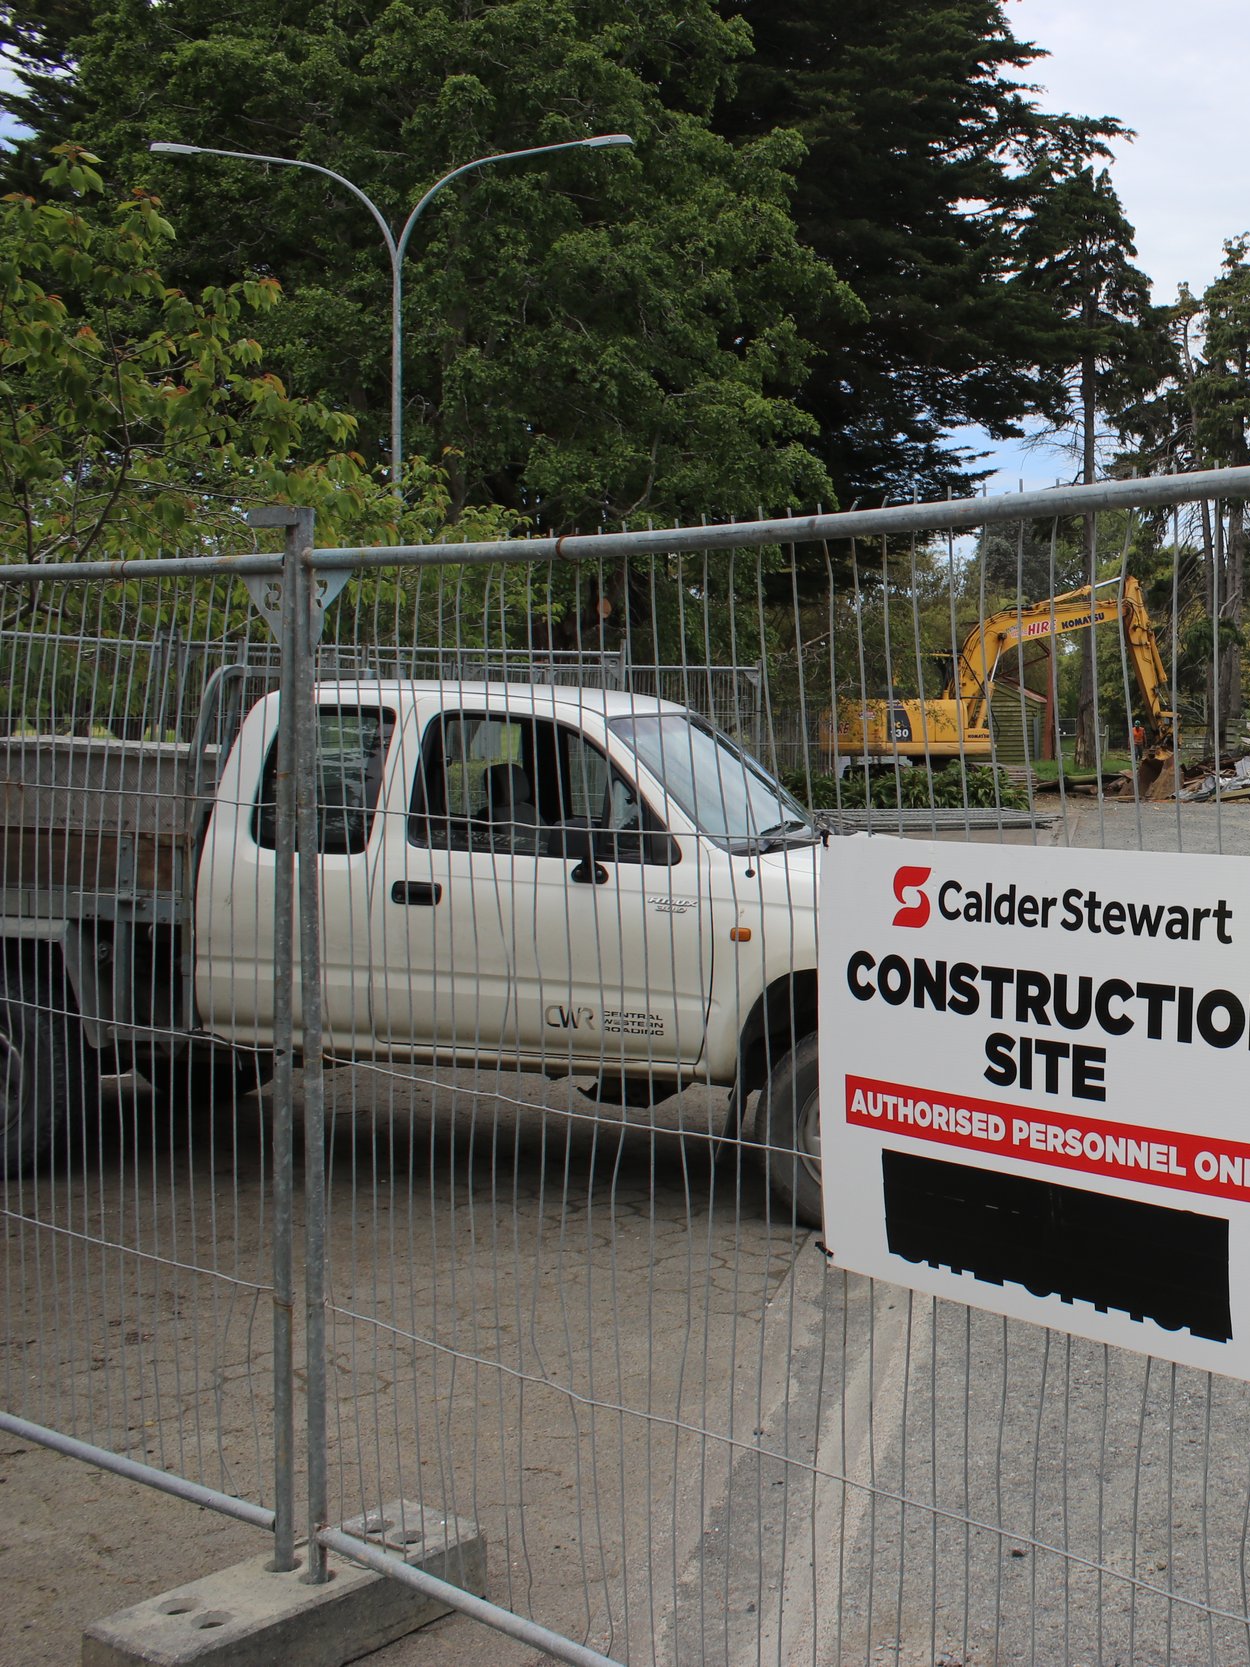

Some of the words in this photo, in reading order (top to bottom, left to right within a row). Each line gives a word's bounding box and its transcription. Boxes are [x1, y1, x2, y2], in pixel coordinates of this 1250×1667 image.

[1061, 612, 1105, 630] KOMATSU
[545, 1005, 595, 1031] CWR
[602, 1010, 663, 1021] CENTRAL
[602, 1018, 664, 1029] WESTERN
[602, 1026, 665, 1036] ROADING
[983, 1032, 1107, 1102] SITE
[850, 1088, 1006, 1141] AUTHORISED
[1012, 1118, 1187, 1177] PERSONNEL
